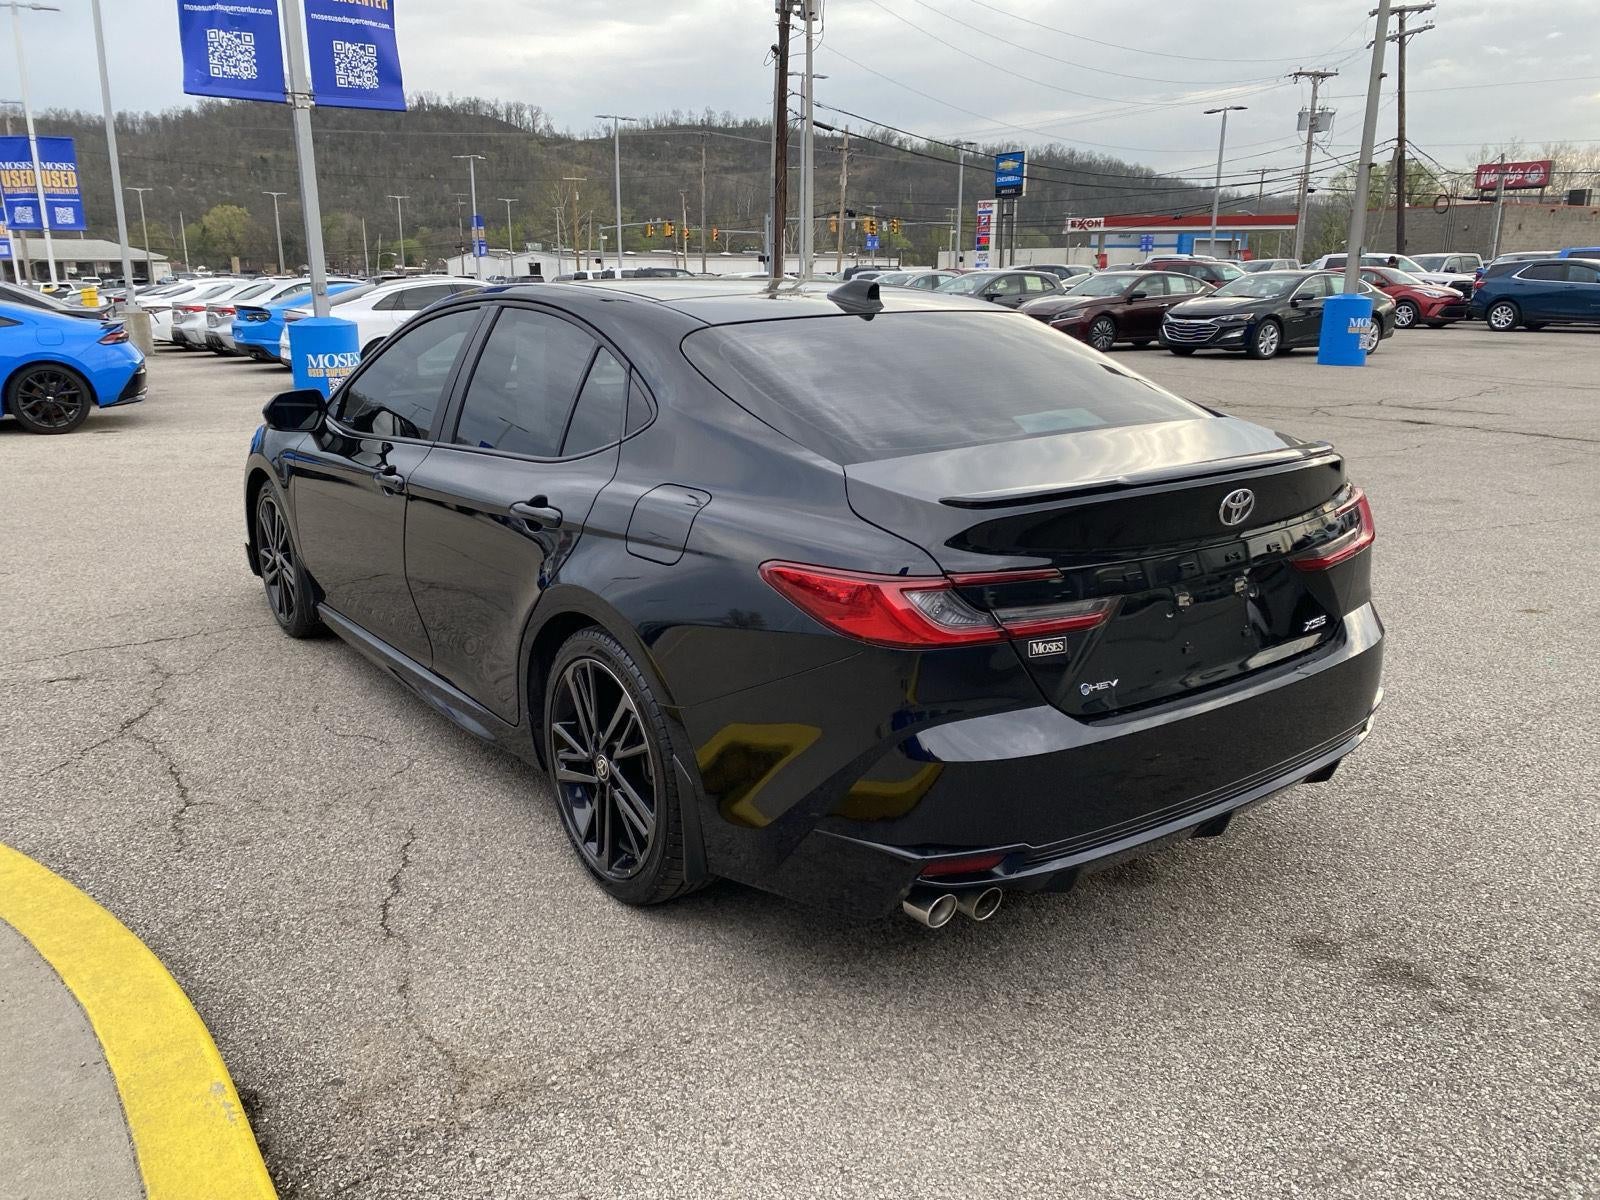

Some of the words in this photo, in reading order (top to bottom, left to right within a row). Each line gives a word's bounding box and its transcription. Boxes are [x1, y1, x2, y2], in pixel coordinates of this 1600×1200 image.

[183, 3, 273, 16] mosesusedsupercenter.com
[311, 13, 390, 29] mosesusedsupercenter.com
[0, 161, 33, 170] MOSES
[41, 162, 75, 170] MOSES
[1, 170, 36, 187] USED
[41, 170, 78, 188] USED
[1480, 166, 1524, 185] Wedy's
[1070, 218, 1102, 230] EXXON
[307, 353, 359, 368] MOSES
[1032, 641, 1064, 655] MOSES
[1089, 678, 1119, 692] HEV
